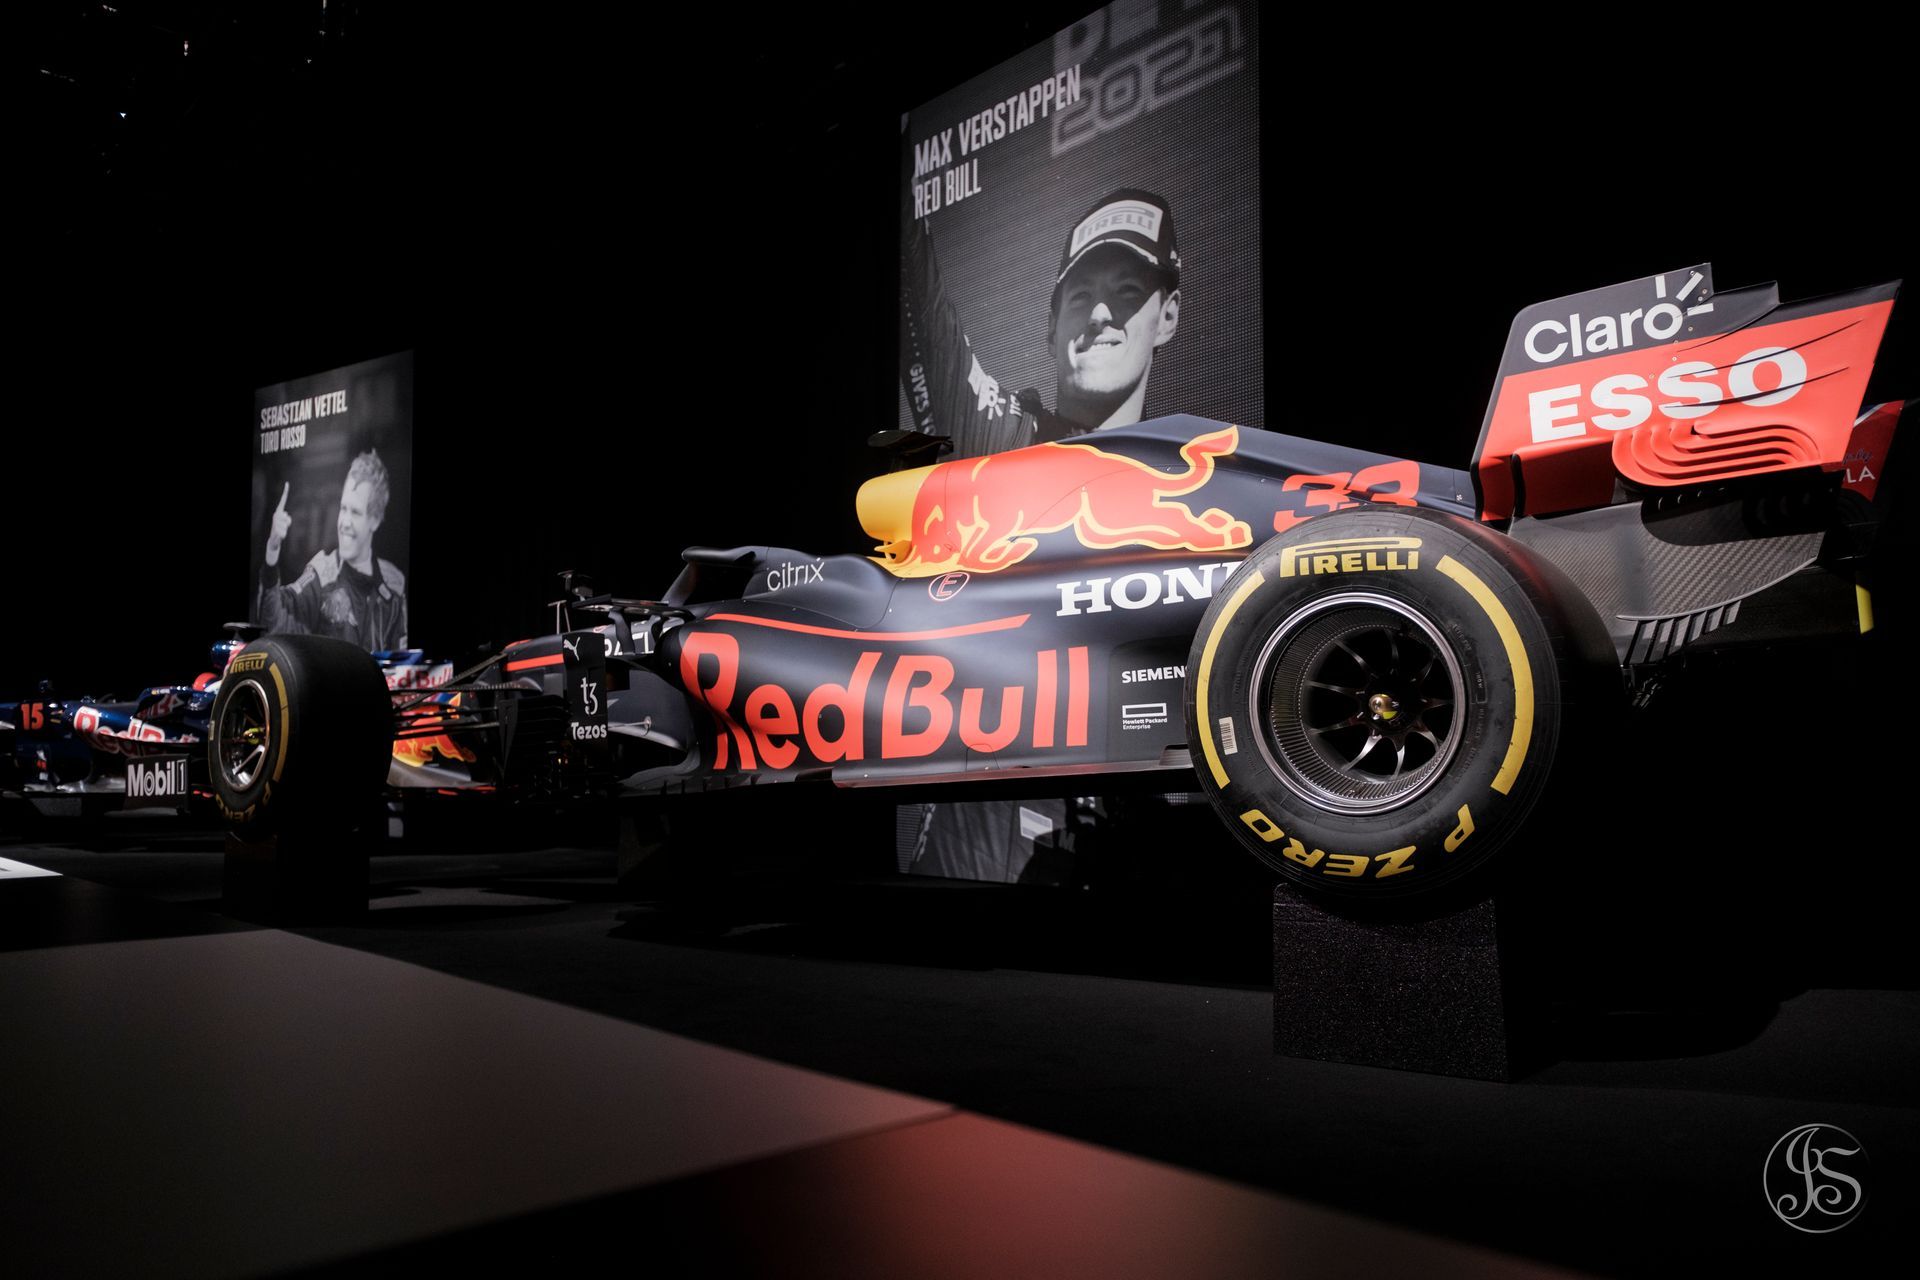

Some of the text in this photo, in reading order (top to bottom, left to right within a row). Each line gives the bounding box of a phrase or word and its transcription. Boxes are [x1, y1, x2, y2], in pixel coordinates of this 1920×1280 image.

[914, 64, 1081, 179] MAX VERSTAPPEN
[914, 159, 982, 220] RED BULL
[1078, 206, 1155, 245] PIRELLI
[1524, 303, 1683, 363] Claro
[260, 389, 348, 430] SEBASTIAN VETTEL
[1528, 346, 1808, 444] ESSO
[260, 424, 307, 455] TORO ROSSO
[766, 557, 825, 592] citrix
[1279, 537, 1423, 578] PIRELLI
[1056, 561, 1245, 617] HON
[230, 652, 268, 674] PIRELLI
[1121, 665, 1188, 684] SIEMEN
[20, 702, 44, 731] 15
[570, 721, 608, 741] Tezos
[127, 761, 176, 798] Mobil
[1239, 803, 1475, 879] P ZERO
